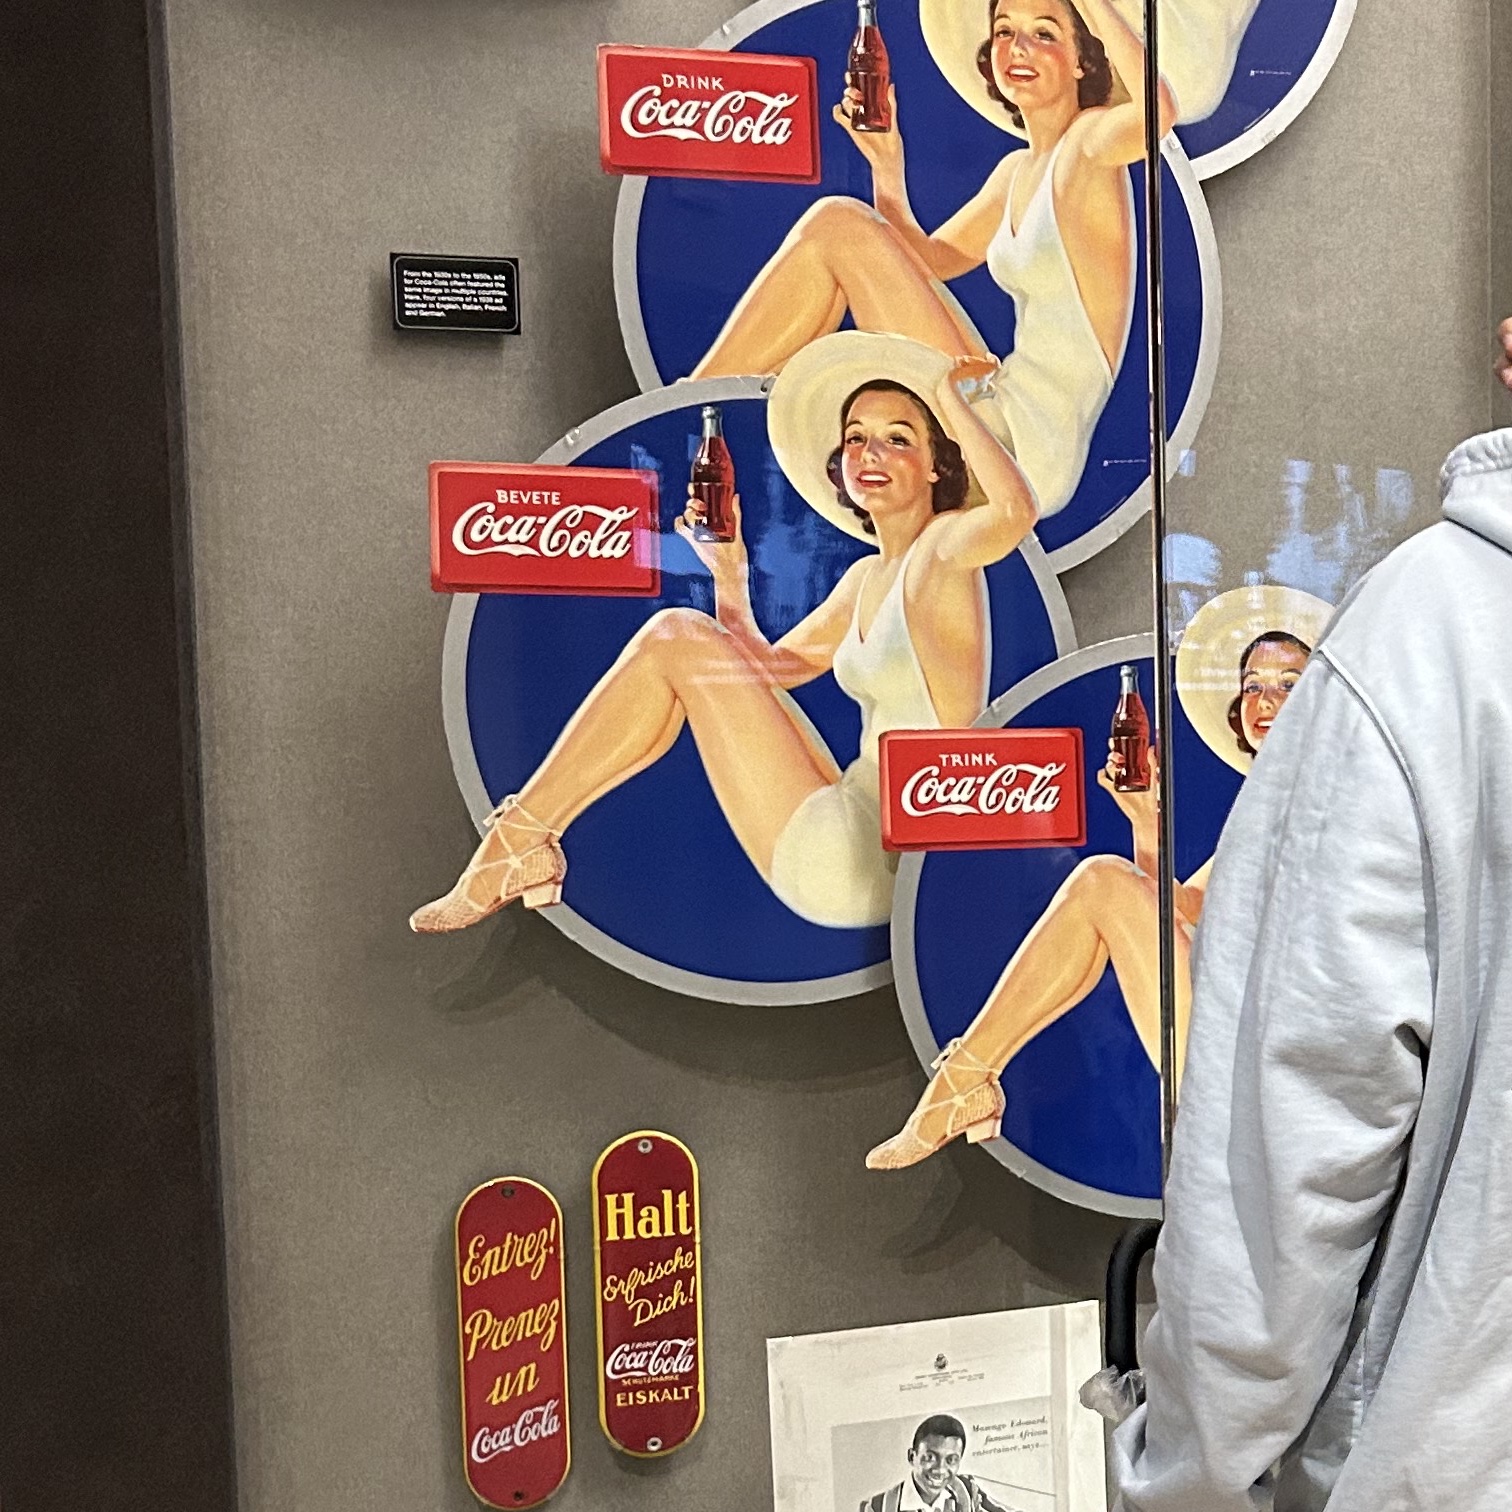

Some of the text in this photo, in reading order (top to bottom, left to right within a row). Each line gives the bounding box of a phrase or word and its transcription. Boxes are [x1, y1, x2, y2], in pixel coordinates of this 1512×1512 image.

[661, 73, 725, 91] DRINK
[620, 85, 799, 145] Coca-Cola
[496, 490, 561, 505] BEVETE
[452, 501, 639, 558] Coca-Cola
[939, 753, 998, 767] TRINK
[901, 762, 1066, 817] Coca-Cola
[604, 1189, 692, 1242] Halt
[463, 1218, 557, 1287] Entrez!
[603, 1245, 695, 1313] Erfrische
[628, 1275, 696, 1328] Dich!
[464, 1297, 560, 1361] Prenez
[485, 1360, 539, 1408] un
[606, 1337, 696, 1380] Coca-Cola
[616, 1385, 694, 1407] EISKALT
[470, 1399, 561, 1465] Coca-Cola
